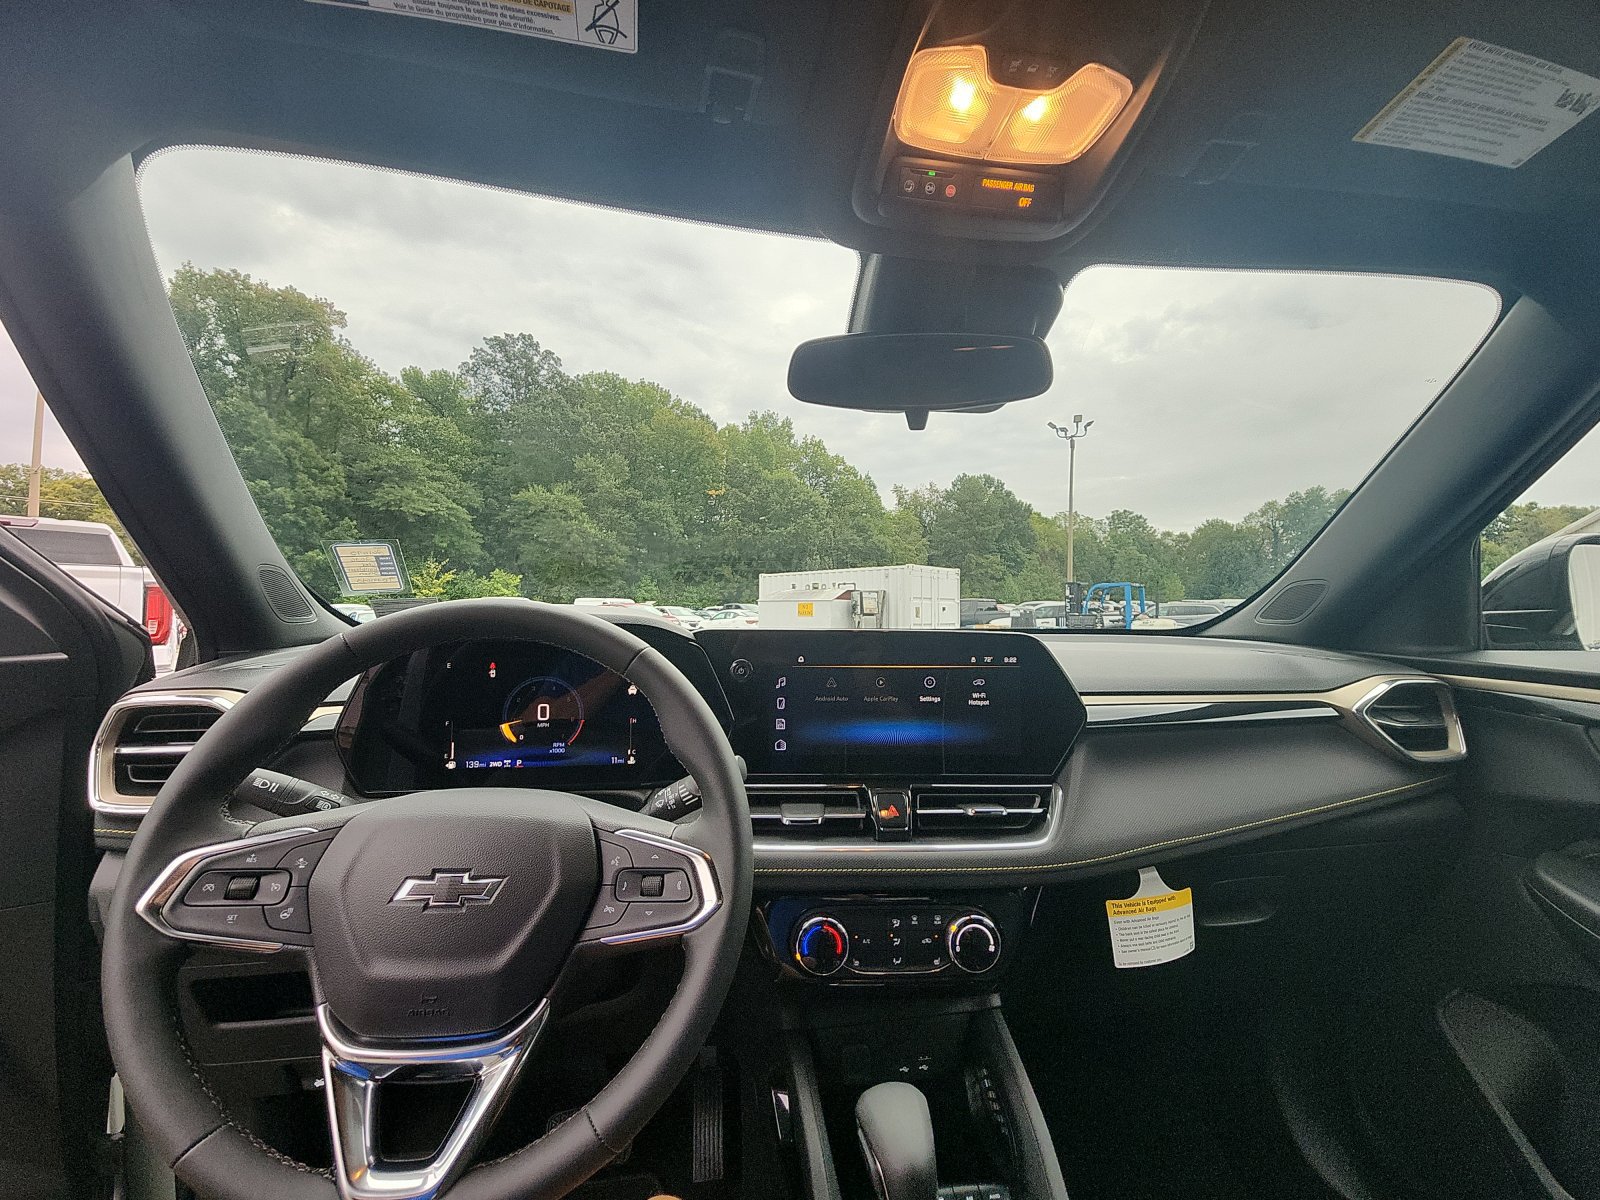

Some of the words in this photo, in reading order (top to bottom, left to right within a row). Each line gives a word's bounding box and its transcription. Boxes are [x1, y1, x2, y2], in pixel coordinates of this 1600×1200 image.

[534, 0, 571, 13] CAPOTAGE
[981, 178, 1014, 190] PASSENGER
[1013, 182, 1035, 193] AIRBAG
[1018, 197, 1033, 208] OFF
[863, 695, 879, 703] Apple
[919, 695, 941, 703] Settings
[968, 699, 990, 707] Hotspot
[537, 703, 550, 721] 0
[1146, 897, 1167, 906] Equipped
